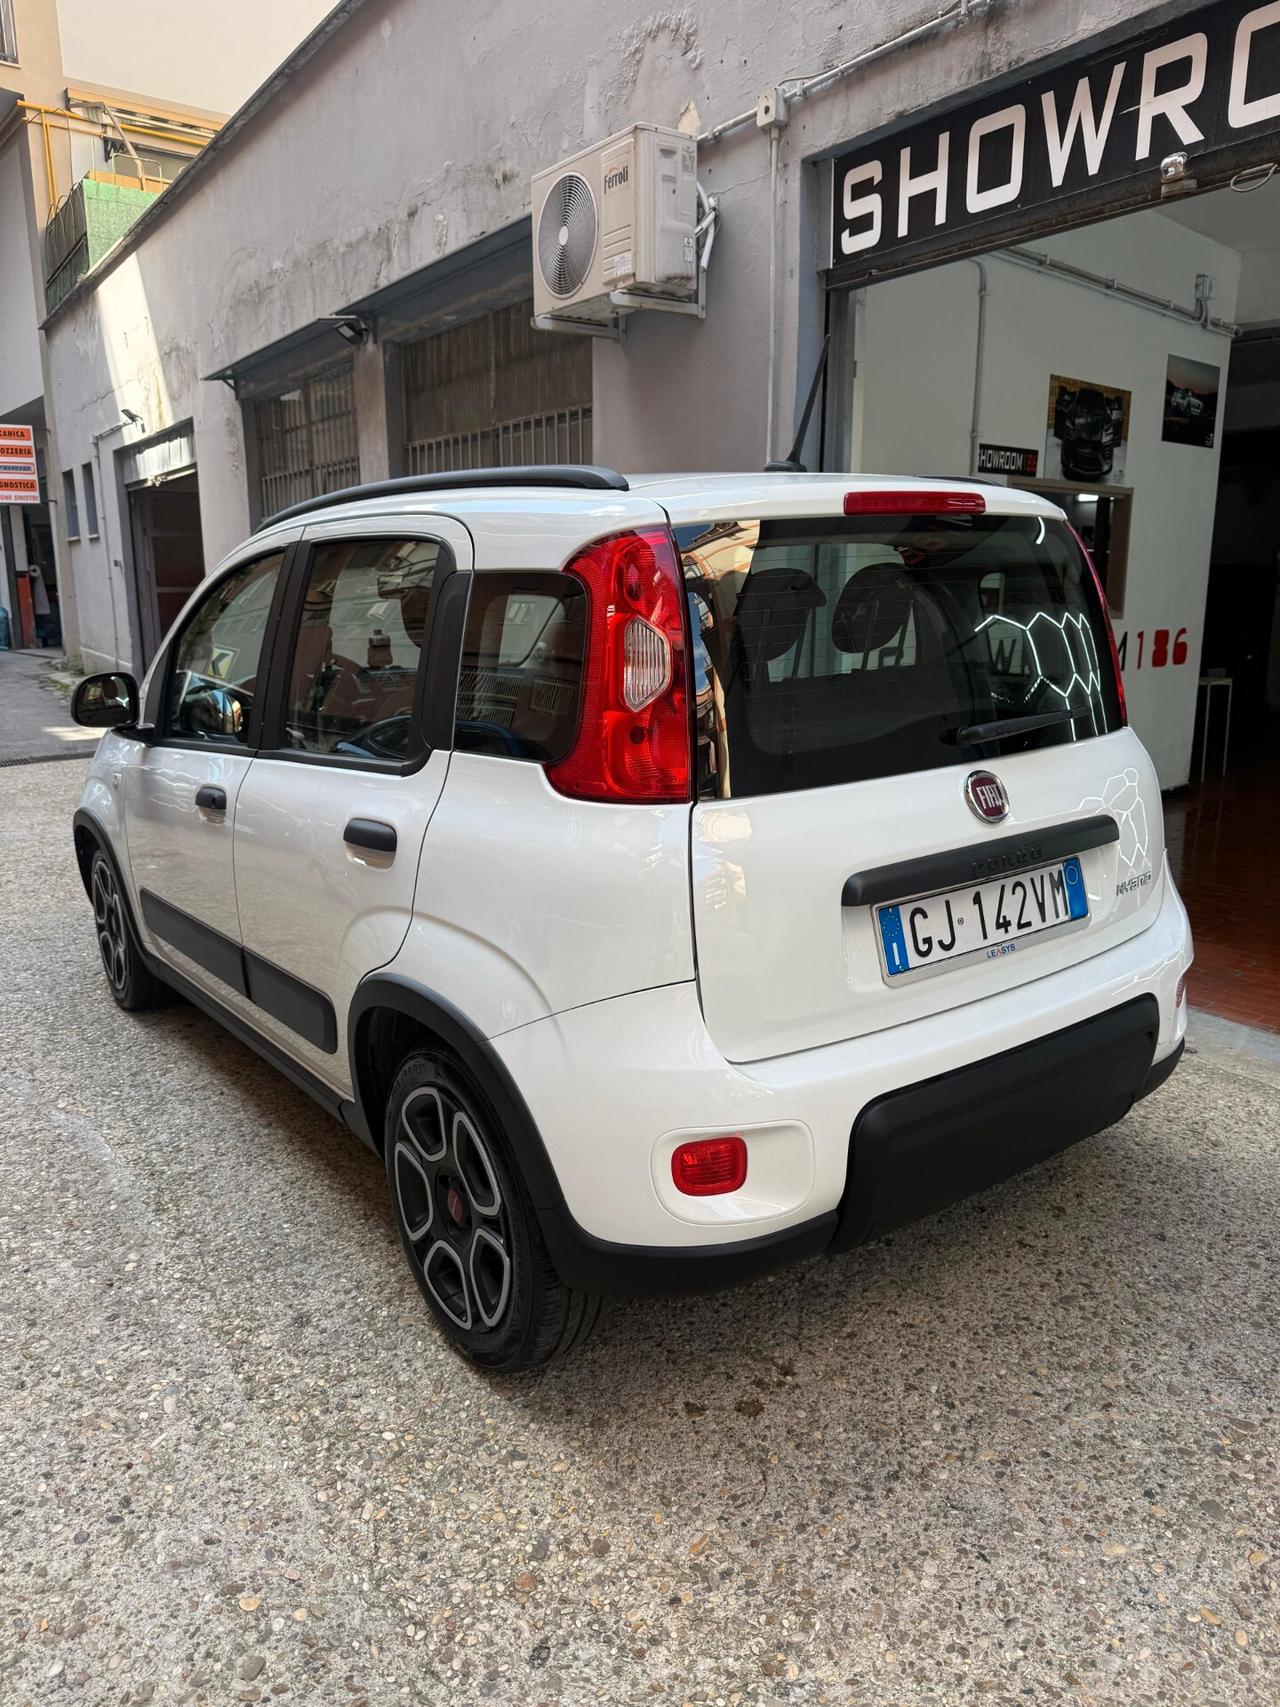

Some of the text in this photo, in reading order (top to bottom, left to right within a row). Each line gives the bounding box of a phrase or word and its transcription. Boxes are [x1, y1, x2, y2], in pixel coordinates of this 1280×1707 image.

[840, 2, 1280, 256] SHOWRO
[603, 165, 629, 194] Ferroli
[976, 783, 1002, 809] FIAT
[1116, 871, 1151, 896] HYBRID
[909, 900, 956, 958] GJ
[972, 868, 1068, 940] 142VM
[986, 943, 1016, 959] LEASYS
